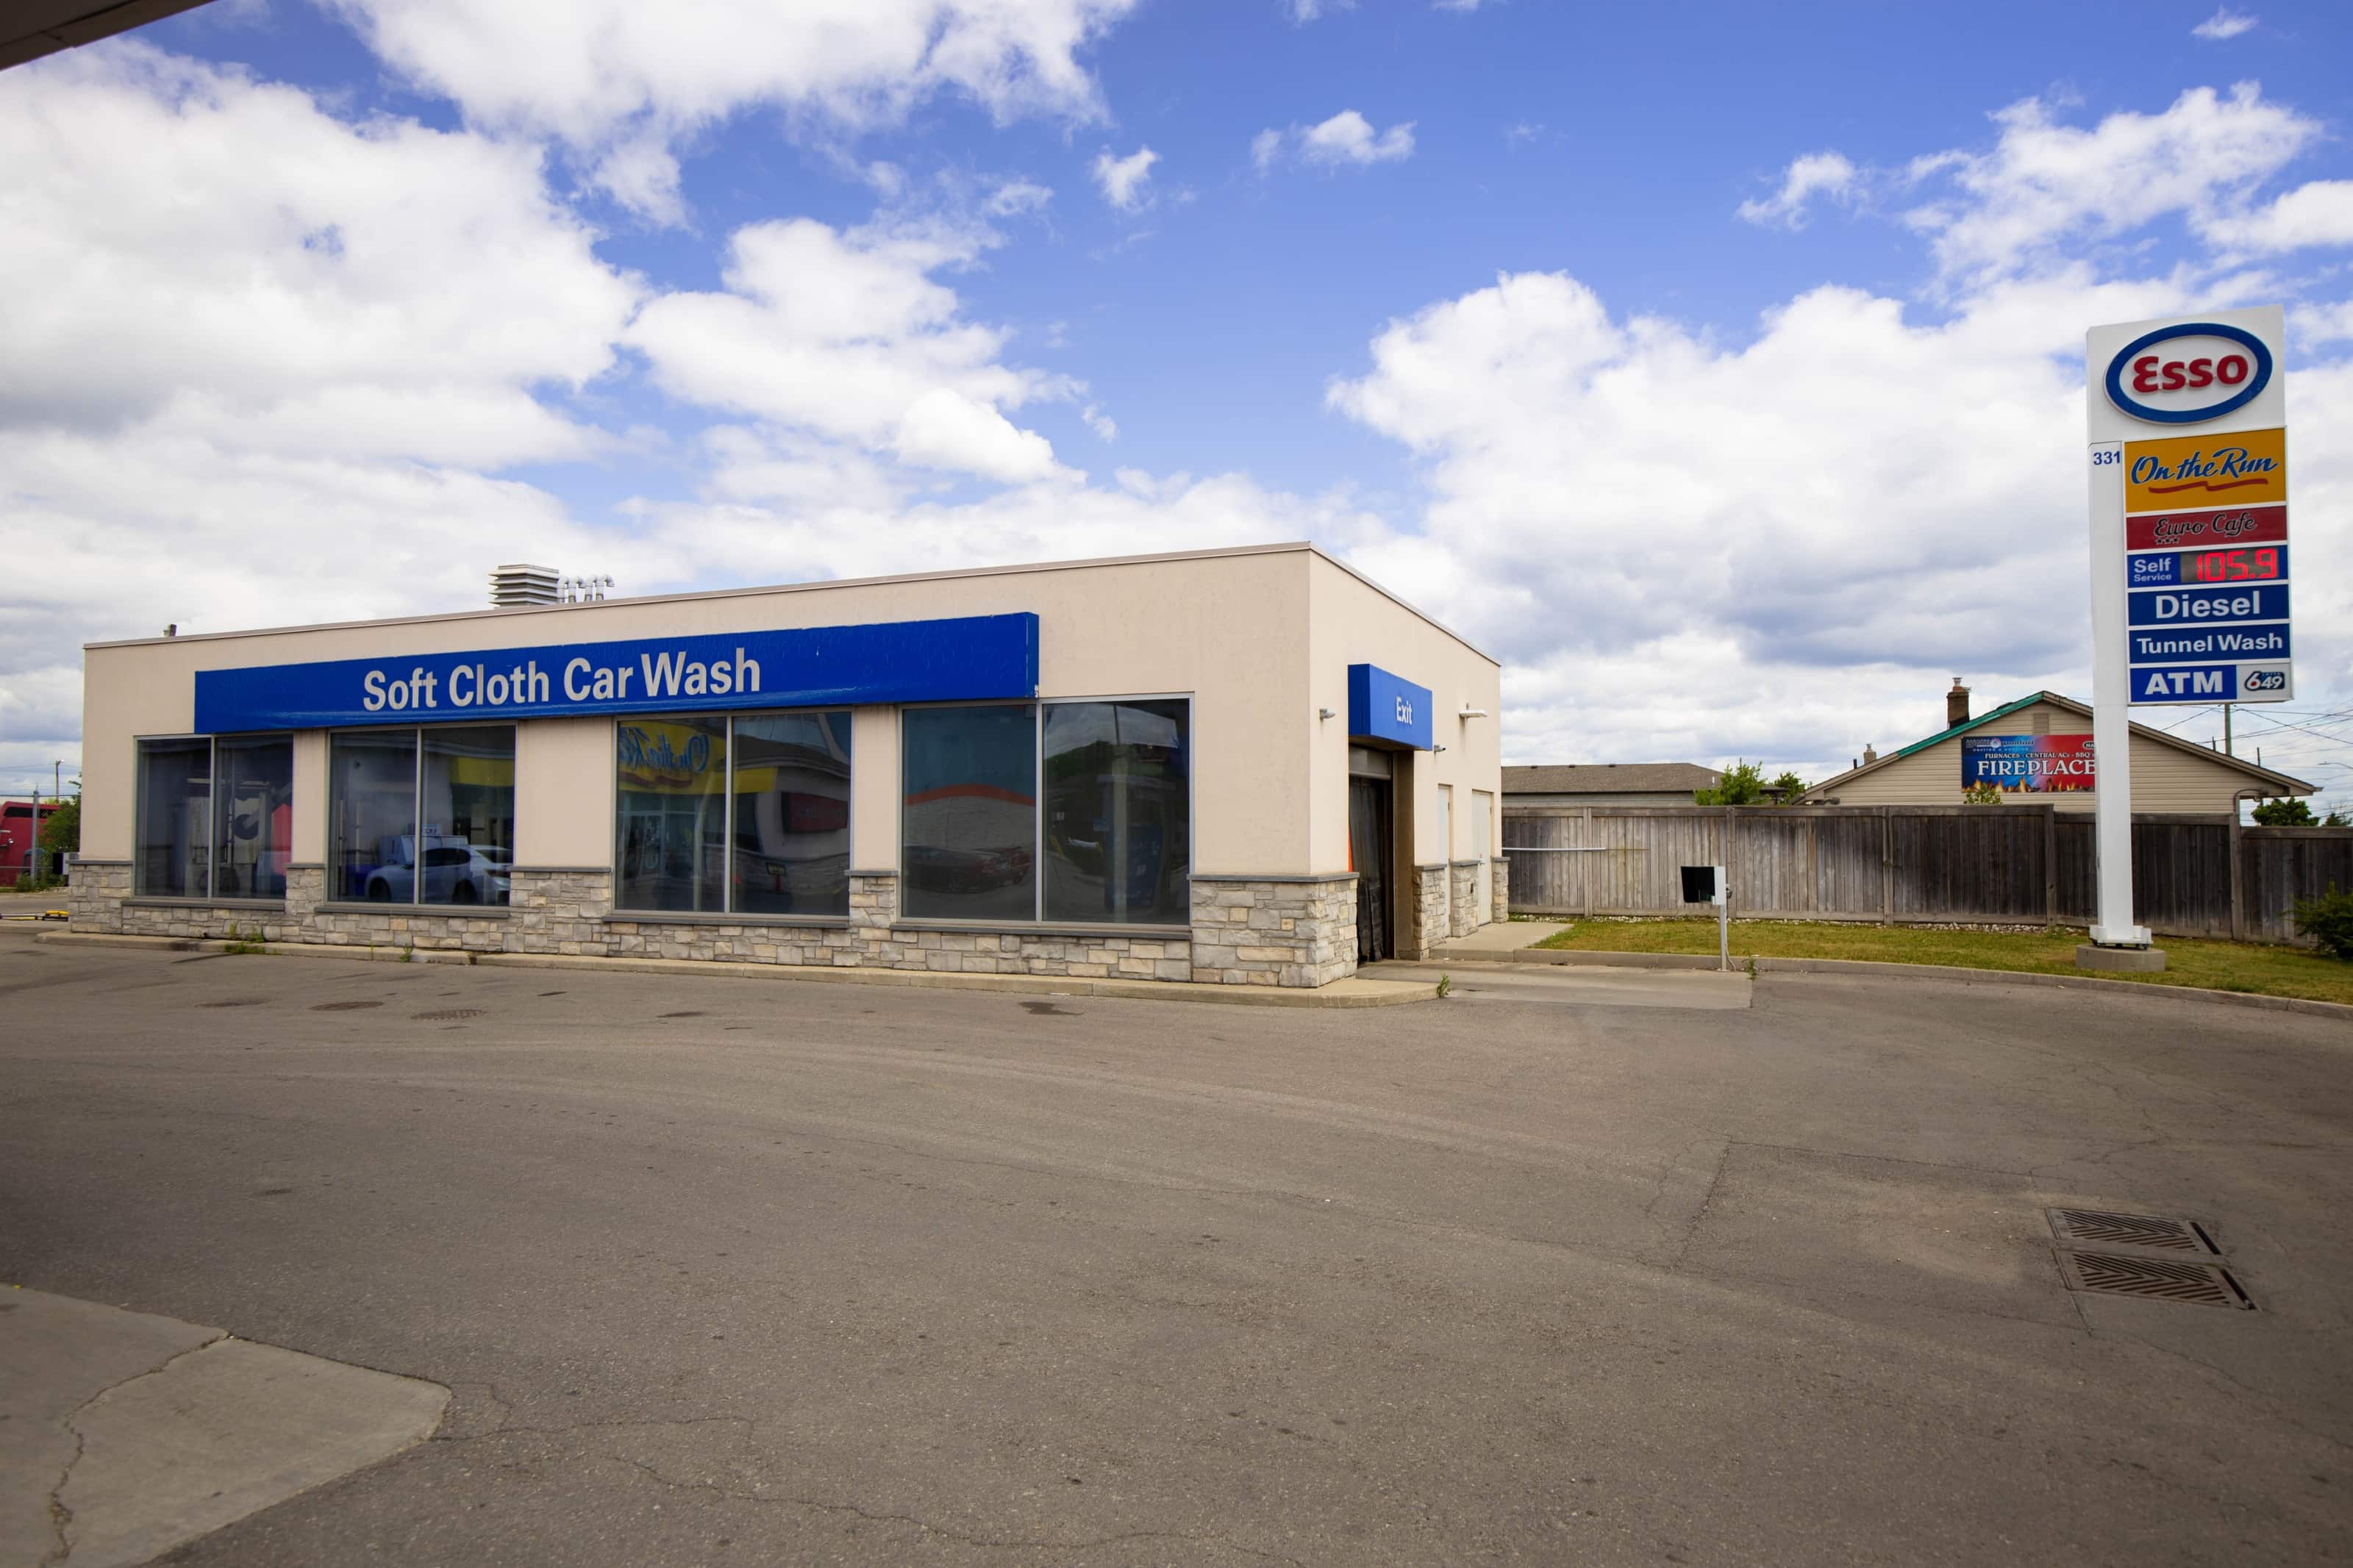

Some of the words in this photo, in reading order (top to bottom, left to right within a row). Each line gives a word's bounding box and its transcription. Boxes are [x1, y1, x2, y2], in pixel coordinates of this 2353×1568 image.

[2093, 451, 2121, 465] 331
[2131, 456, 2174, 484] On
[2176, 451, 2218, 480] the
[2213, 447, 2278, 479] Run
[2154, 518, 2206, 537] Euro
[2212, 512, 2257, 537] Cafe
[2134, 557, 2171, 573] Self
[2134, 572, 2171, 582] Service
[2196, 548, 2278, 581] 105.9
[2155, 590, 2260, 619] Diesel
[2136, 635, 2213, 654] Tunnel
[2218, 633, 2283, 652] Wash
[363, 667, 438, 711] Soft
[449, 661, 549, 706] Cloth
[564, 657, 633, 701] Car
[640, 647, 760, 697] Wash
[2144, 670, 2223, 695] ATM
[1396, 696, 1412, 725] Exit
